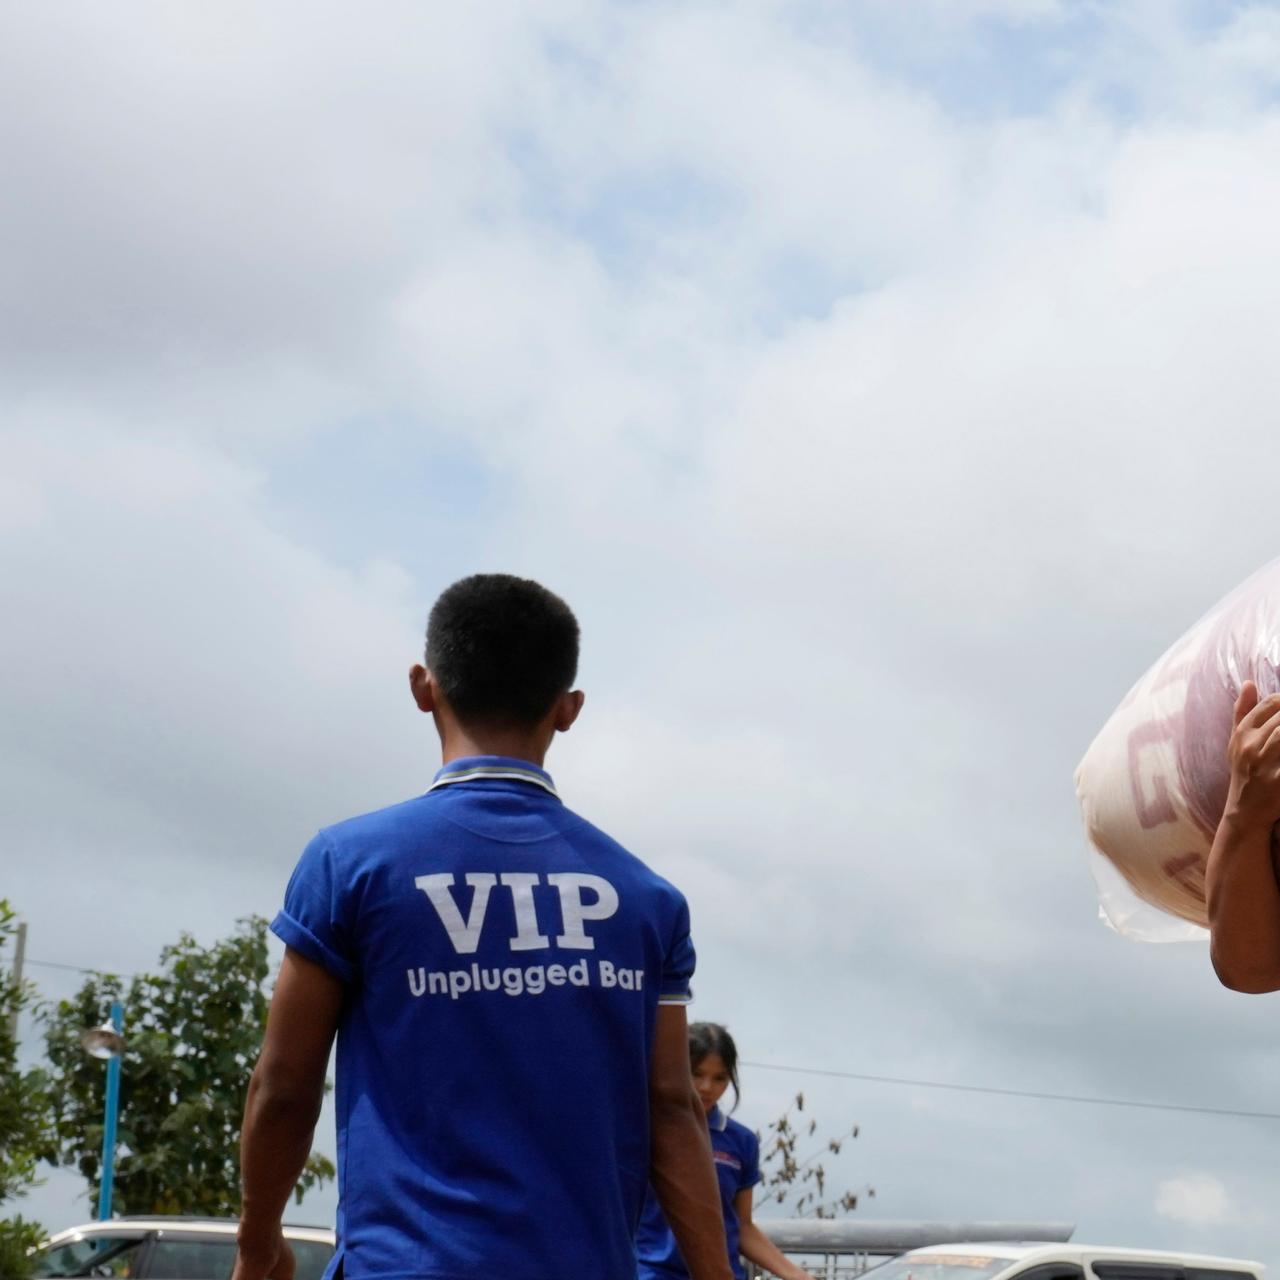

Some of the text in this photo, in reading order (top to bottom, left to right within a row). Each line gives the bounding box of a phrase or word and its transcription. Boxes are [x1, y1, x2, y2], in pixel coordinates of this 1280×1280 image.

[415, 872, 619, 953] VIP
[407, 959, 644, 999] Unplugged Bar
